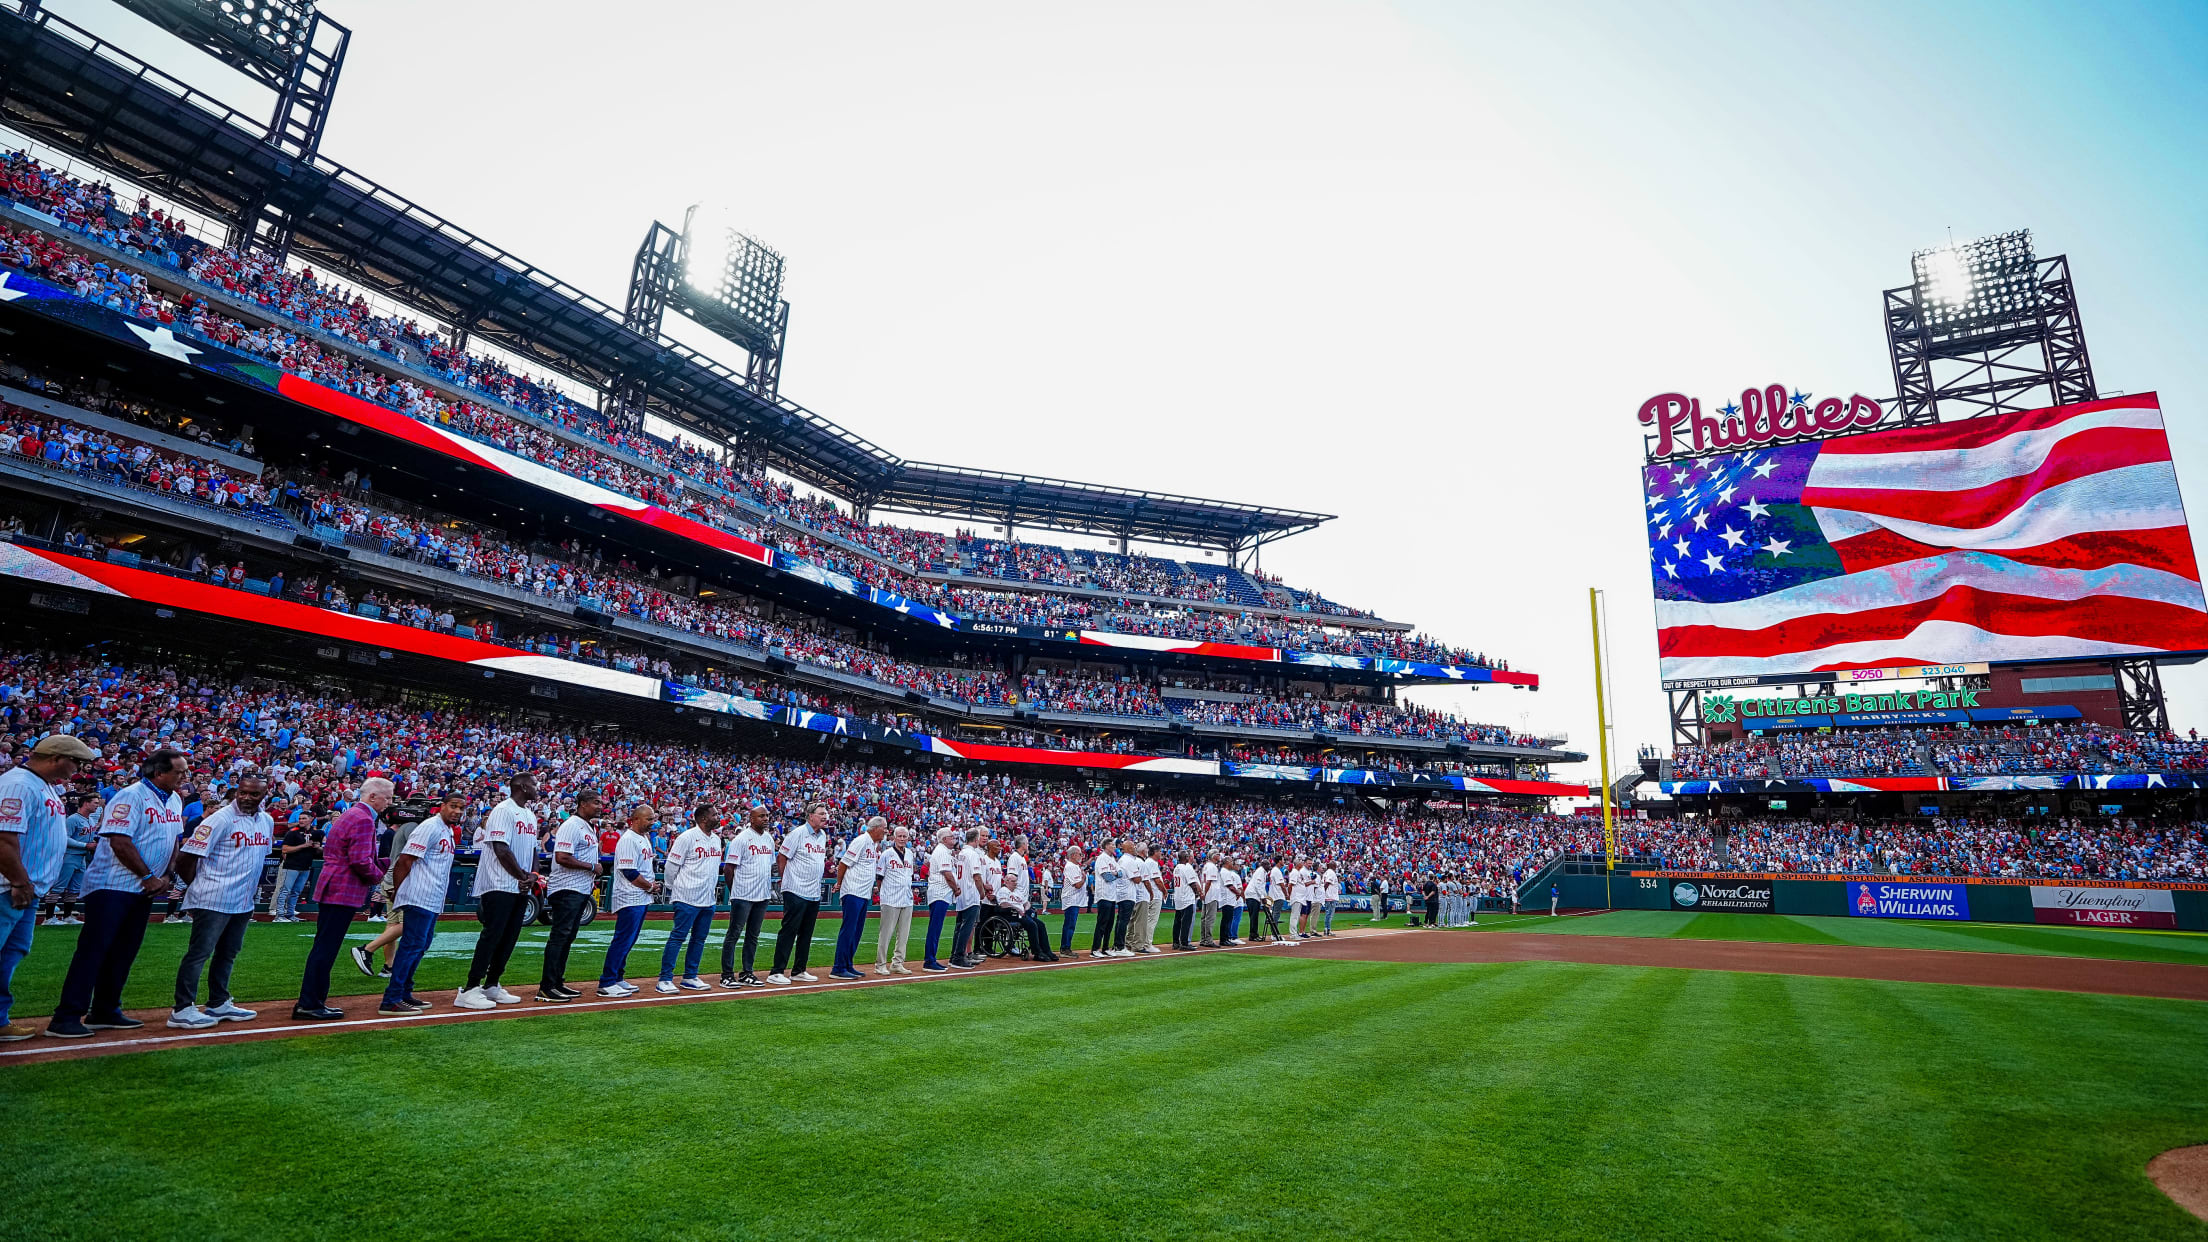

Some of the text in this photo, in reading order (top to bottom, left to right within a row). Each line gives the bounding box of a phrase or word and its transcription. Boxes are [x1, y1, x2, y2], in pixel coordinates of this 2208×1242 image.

[1638, 384, 1882, 457] Phillies
[973, 623, 1018, 634] 6:56:17 PM
[1921, 665, 1966, 676] $23,040
[1663, 682, 1674, 690] OUT
[1683, 680, 1707, 688] RESPECT
[1708, 679, 1720, 687] FOR
[1733, 677, 1759, 686] COUNTRY
[1741, 686, 1980, 716] Citizens Bank Park
[1850, 713, 1899, 721] HARRY
[1640, 879, 1658, 889] 334
[1713, 872, 1765, 880] ASPLUNDH
[1775, 873, 1829, 881] ASPLUNDH
[1908, 876, 1968, 884] ASPLUNDH
[1981, 878, 2045, 886] ASPLUNDH
[2058, 881, 2126, 889] ASPLUNDH
[1700, 884, 1770, 899] NovaCare
[1880, 886, 1952, 901] SHERWIN
[1701, 900, 1769, 908] REHABILITATION
[2058, 889, 2146, 910] Yuengling
[2074, 911, 2133, 924] LAGER
